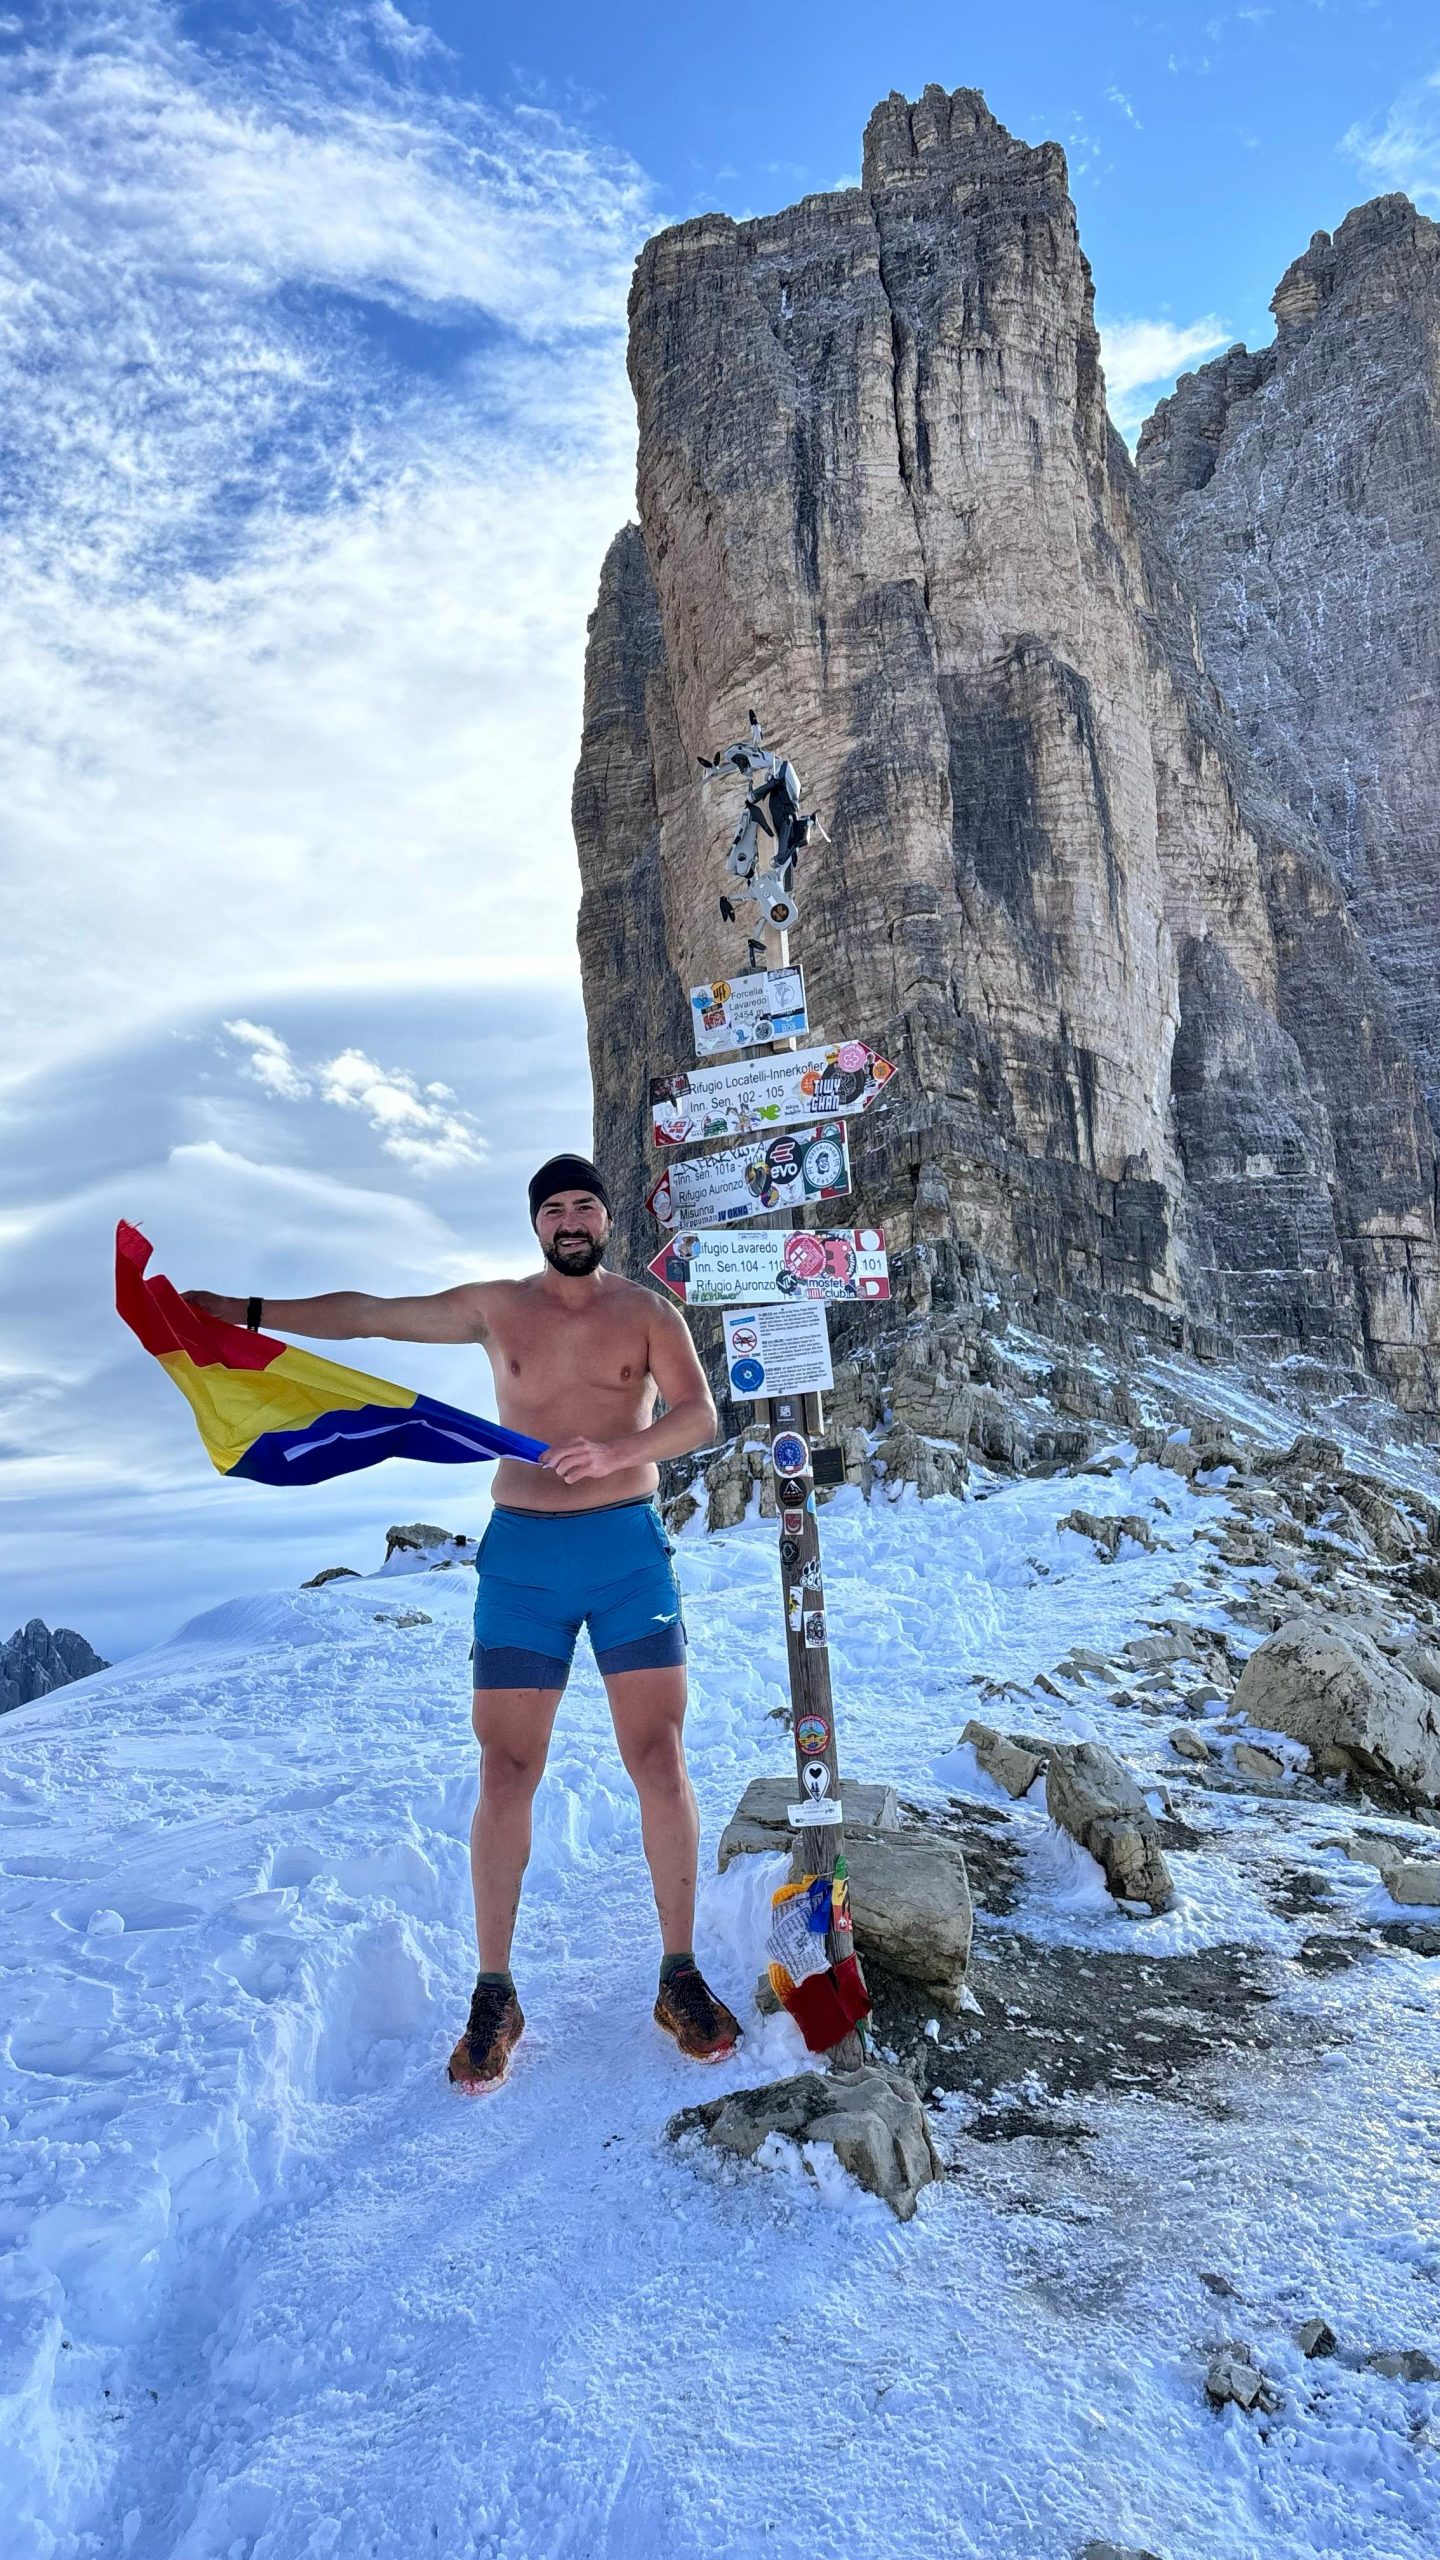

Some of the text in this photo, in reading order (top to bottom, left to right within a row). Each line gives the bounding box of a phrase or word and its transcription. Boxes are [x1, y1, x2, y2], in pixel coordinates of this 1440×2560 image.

[731, 987, 763, 1000] Forcella
[729, 997, 767, 1011] Lavaredo
[734, 1010, 753, 1020] 2454
[690, 1081, 722, 1095] Rifugio
[726, 1061, 824, 1088] Locatelli-Innerkofler
[813, 1078, 841, 1097] TIWY
[690, 1102, 709, 1112] Inn.
[711, 1097, 733, 1109] Sen.
[737, 1091, 755, 1103] 102
[766, 1086, 784, 1099] 105
[810, 1095, 840, 1113] CHAN
[677, 1174, 693, 1186] Inn.
[695, 1170, 712, 1181] sen.
[715, 1163, 735, 1176] 101a
[770, 1163, 798, 1179] evo
[679, 1180, 744, 1203] Rifugio Auronzo
[680, 1204, 714, 1220] Misunna
[717, 1205, 748, 1222] JV OKNA
[699, 1242, 778, 1256] ifugio Lavaredo
[695, 1261, 714, 1272] Inn.
[717, 1261, 739, 1273] Sen.
[742, 1261, 758, 1272] 104
[863, 1259, 882, 1270] 101
[697, 1280, 776, 1292] Rifugio Auronzo
[808, 1279, 843, 1288] mosfet
[825, 1289, 846, 1298] club
